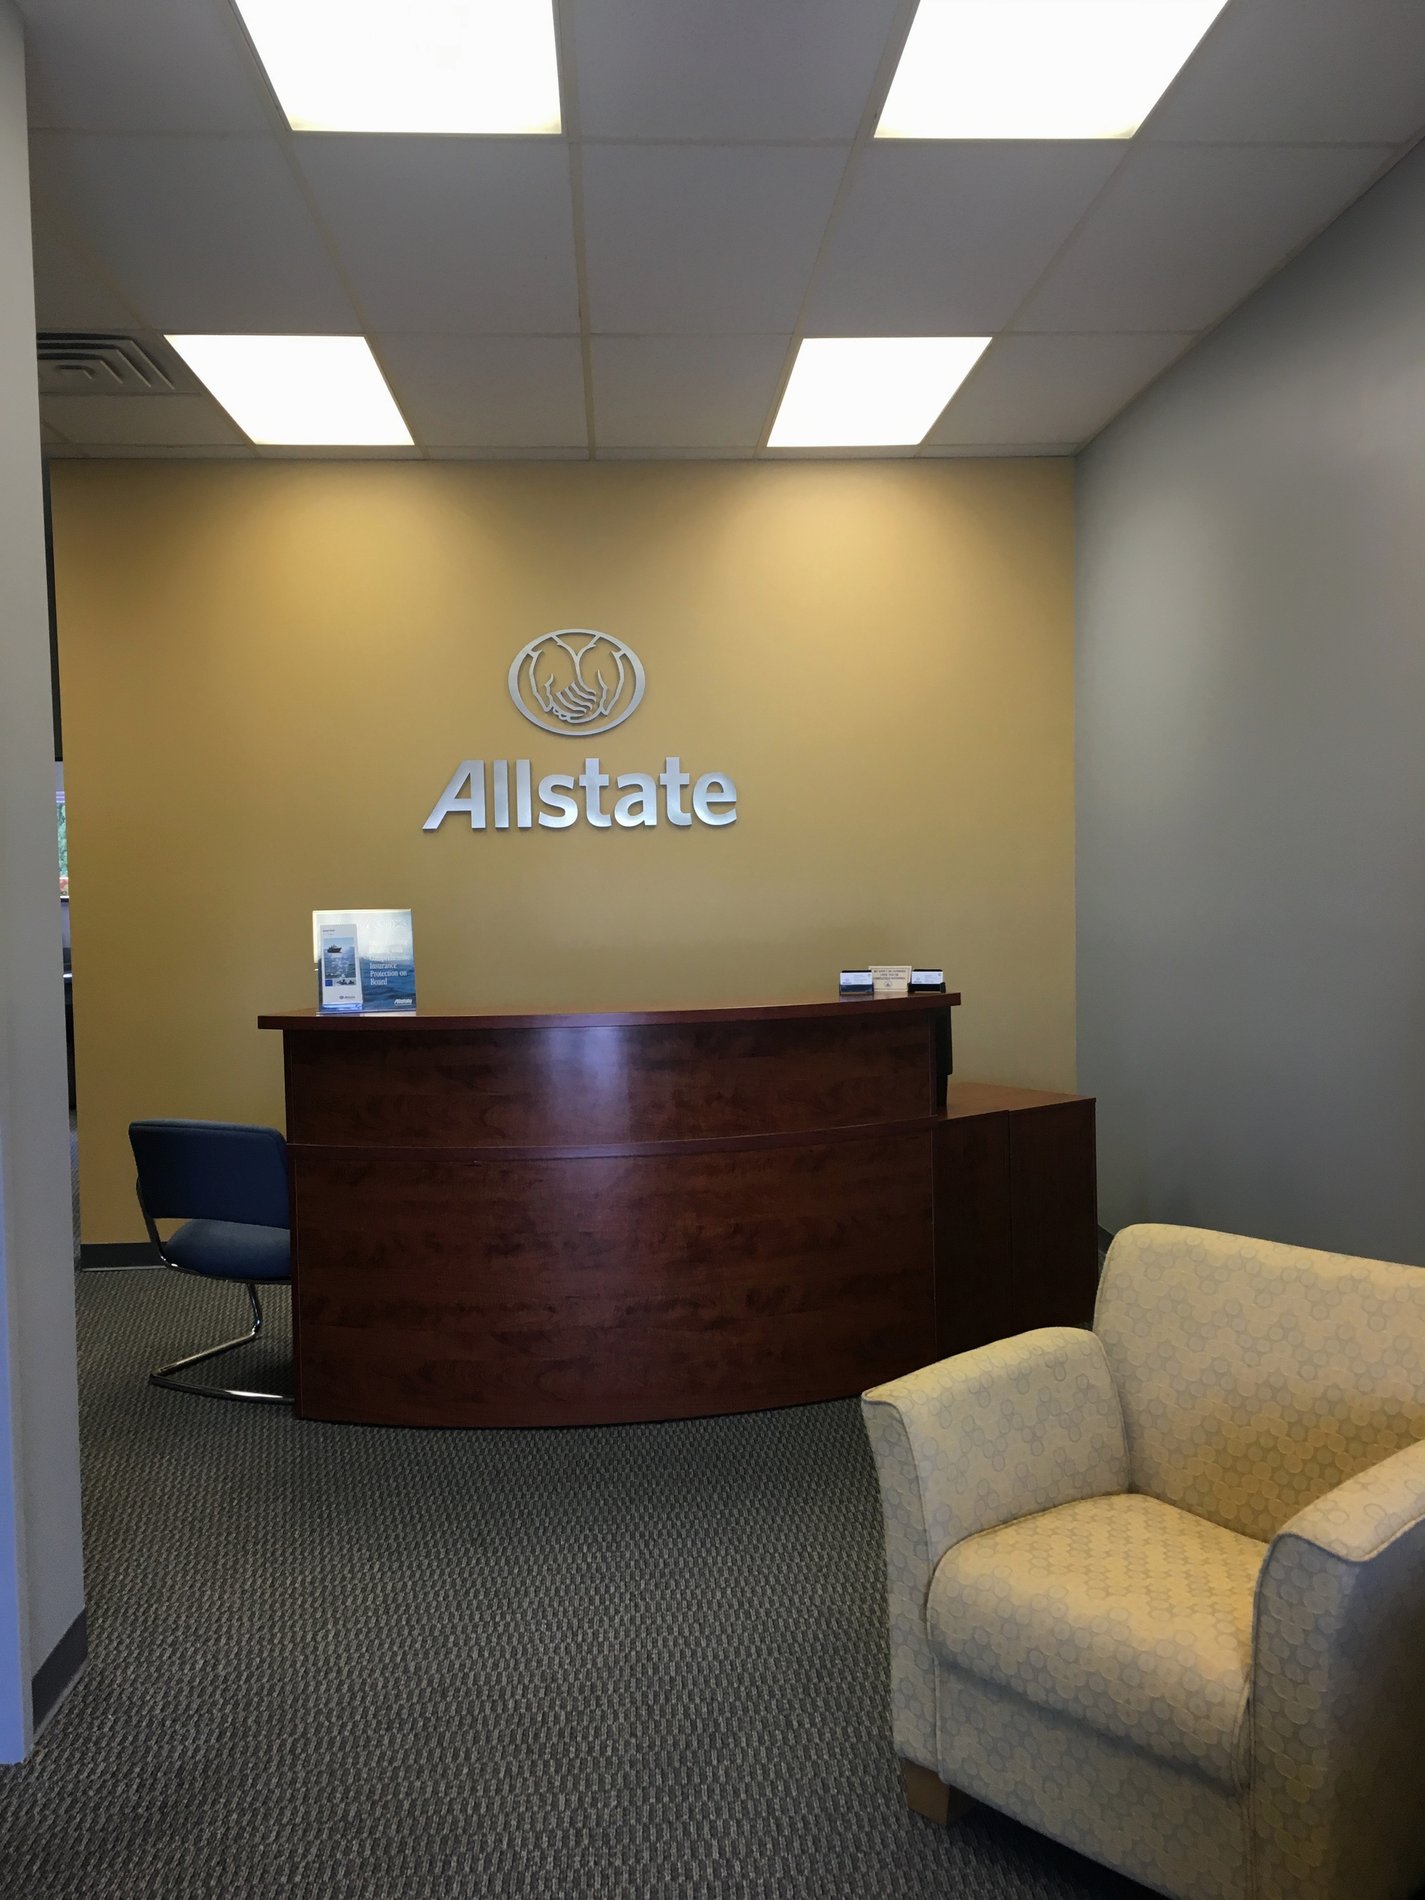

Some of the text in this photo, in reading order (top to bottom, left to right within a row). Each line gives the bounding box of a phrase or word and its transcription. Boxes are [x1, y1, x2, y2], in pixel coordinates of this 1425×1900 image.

[422, 756, 738, 830] Allstate
[370, 970, 399, 978] Protection
[370, 977, 388, 986] Board
